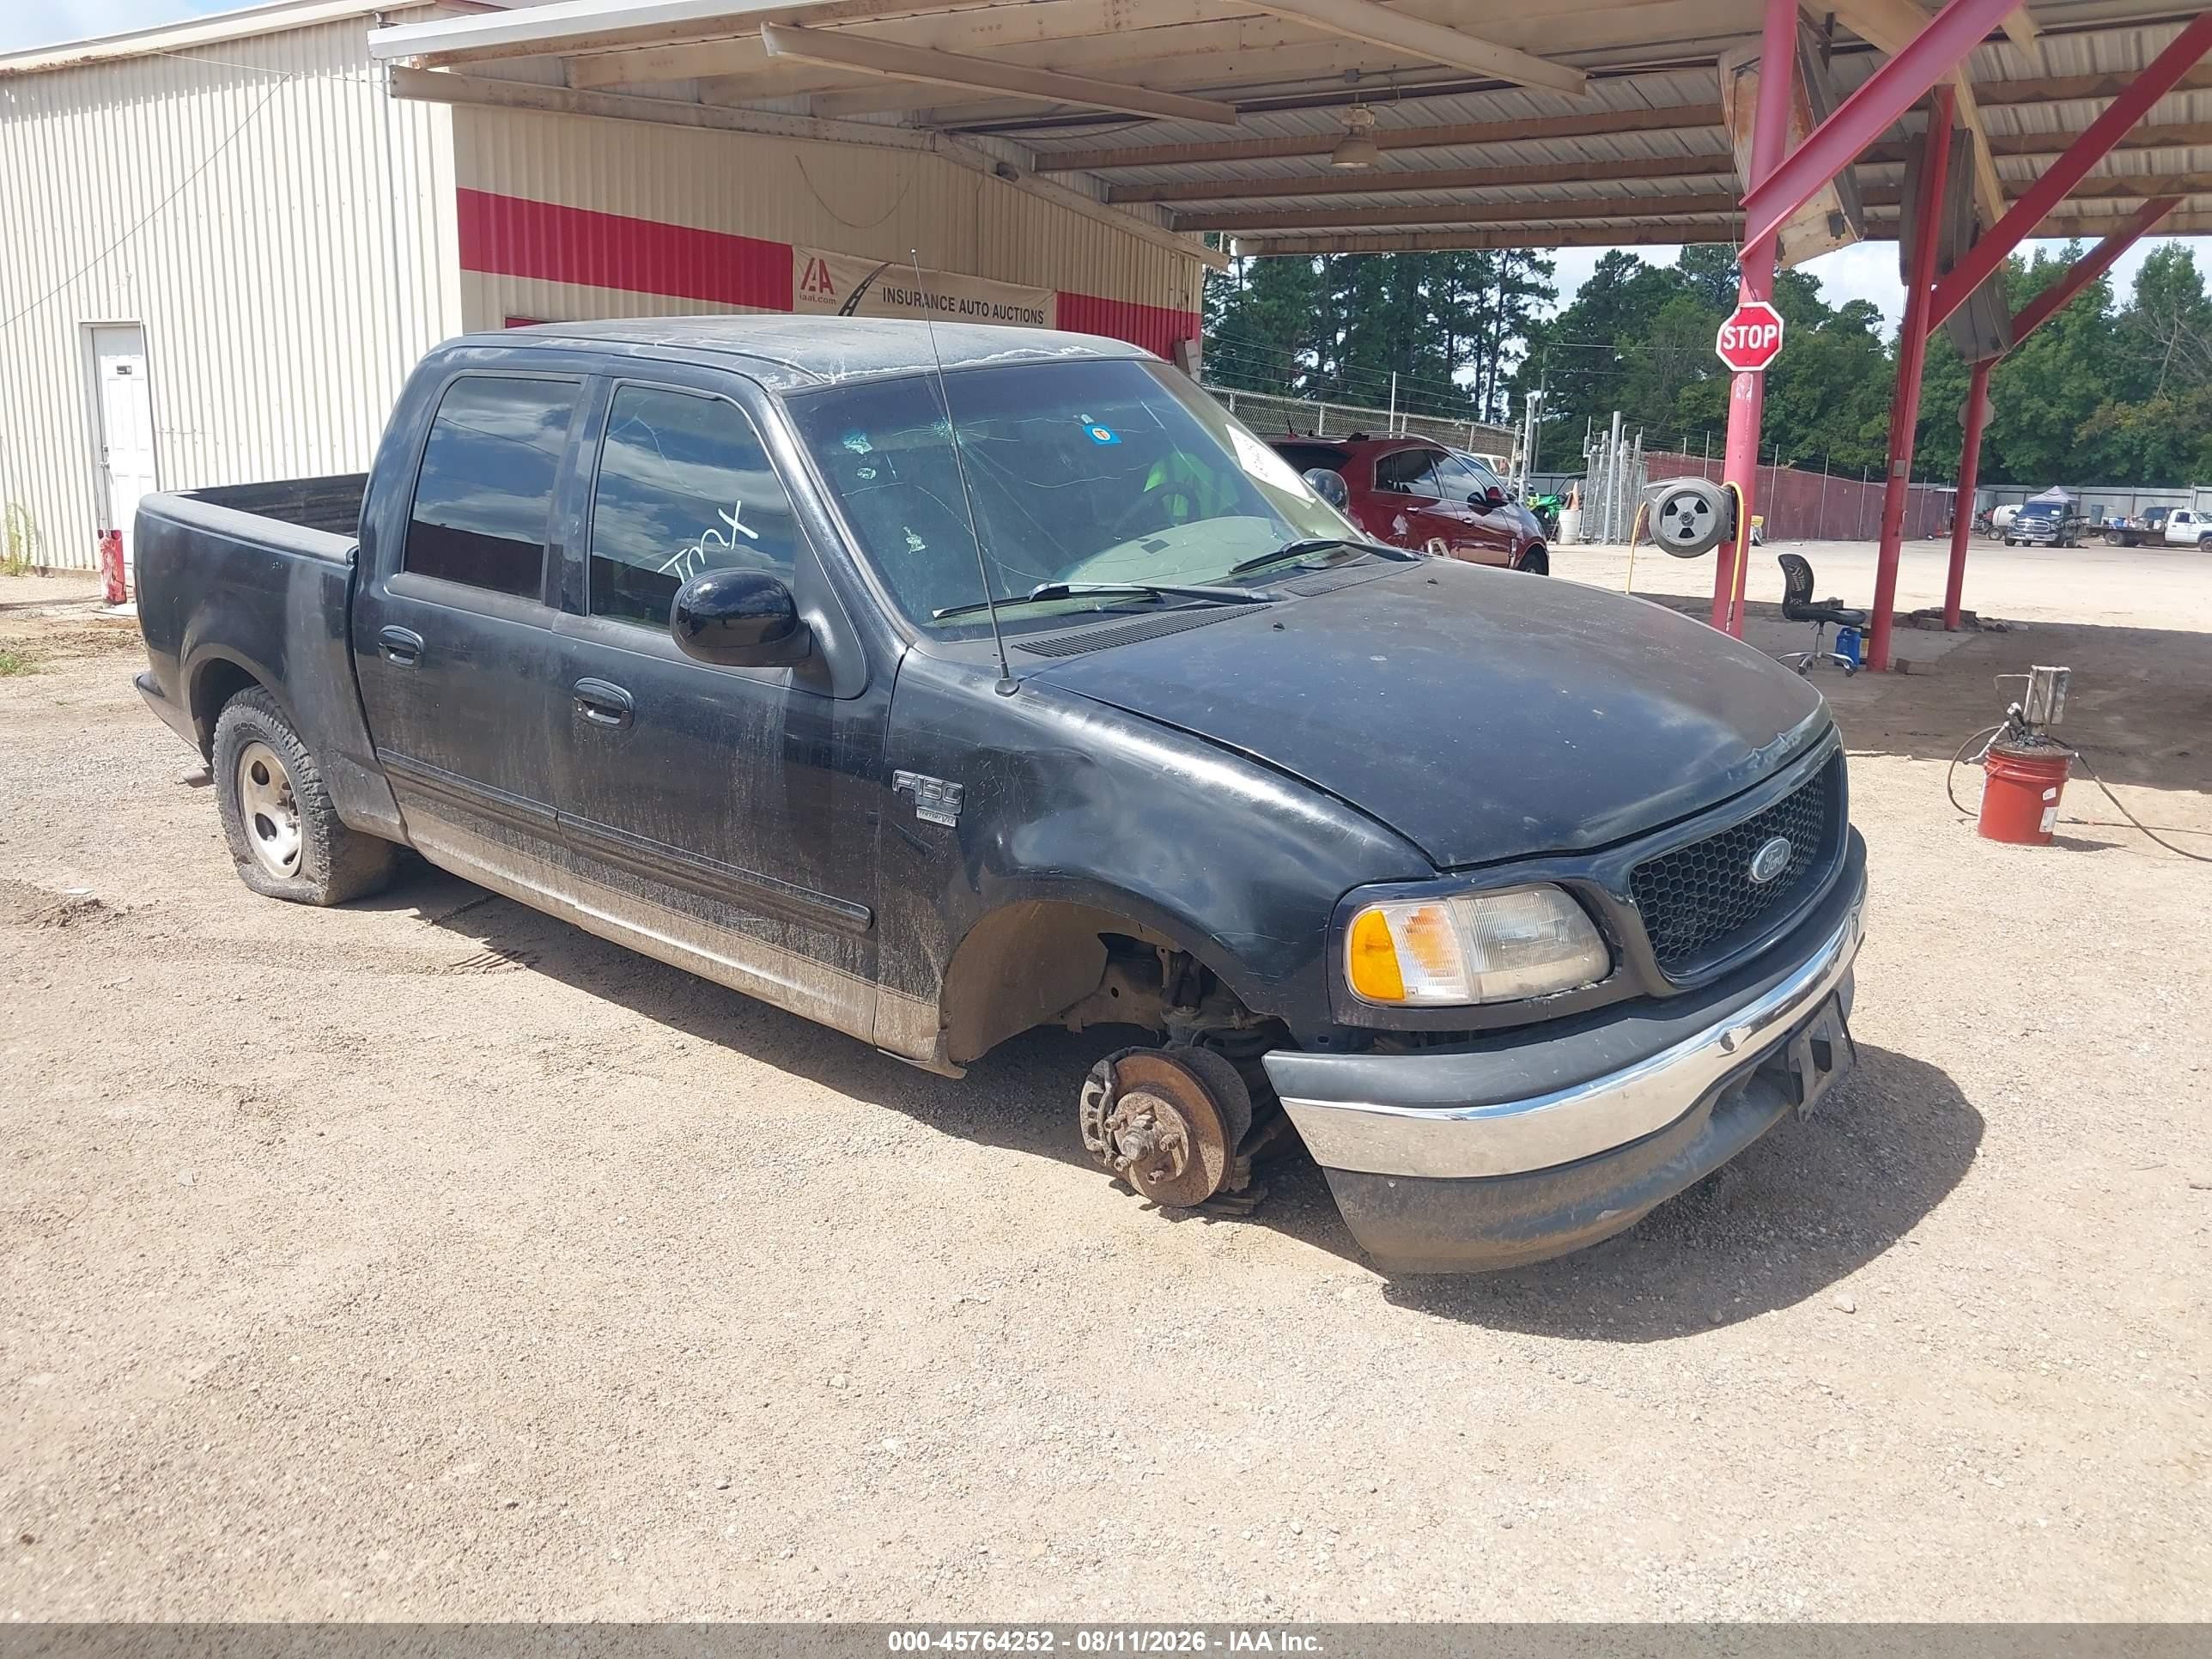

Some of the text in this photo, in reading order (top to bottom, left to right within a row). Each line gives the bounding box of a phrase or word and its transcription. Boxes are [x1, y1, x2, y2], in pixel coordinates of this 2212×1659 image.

[799, 292, 836, 305] iaai.com
[883, 287, 1043, 325] INSURANCE AUTO AUCTIONS
[1723, 325, 1778, 350] STOP
[1764, 847, 1784, 874] Ford
